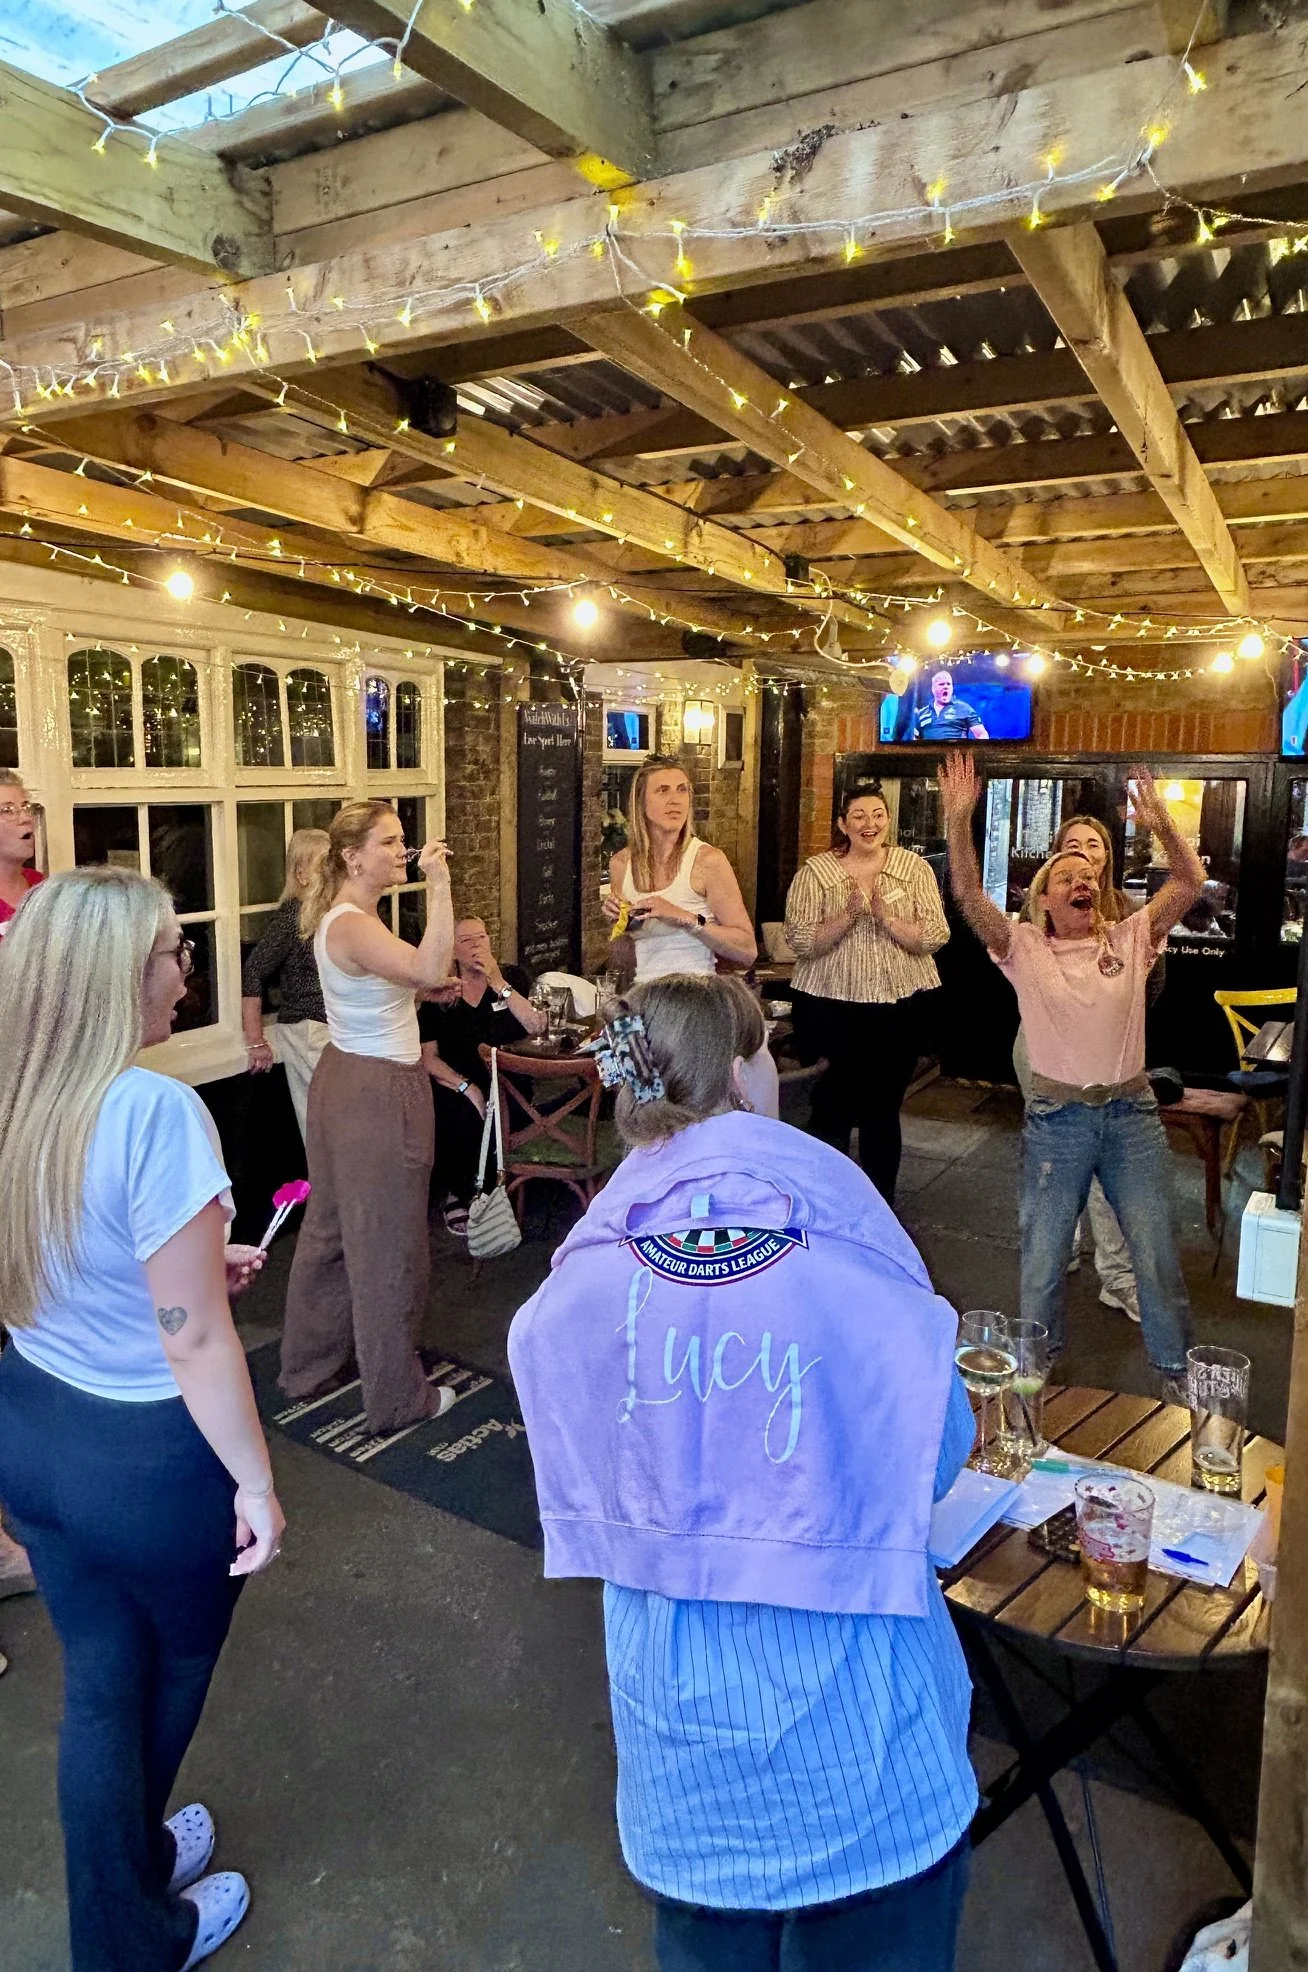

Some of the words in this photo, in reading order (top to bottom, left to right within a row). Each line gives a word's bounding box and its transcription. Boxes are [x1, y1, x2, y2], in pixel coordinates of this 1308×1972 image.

[1181, 945, 1199, 955] Use
[1202, 946, 1226, 958] Only
[640, 1239, 687, 1275] AMATEUR
[688, 1263, 730, 1277] DARTS
[732, 1239, 781, 1272] LEAGUE
[615, 1266, 823, 1465] Lucy
